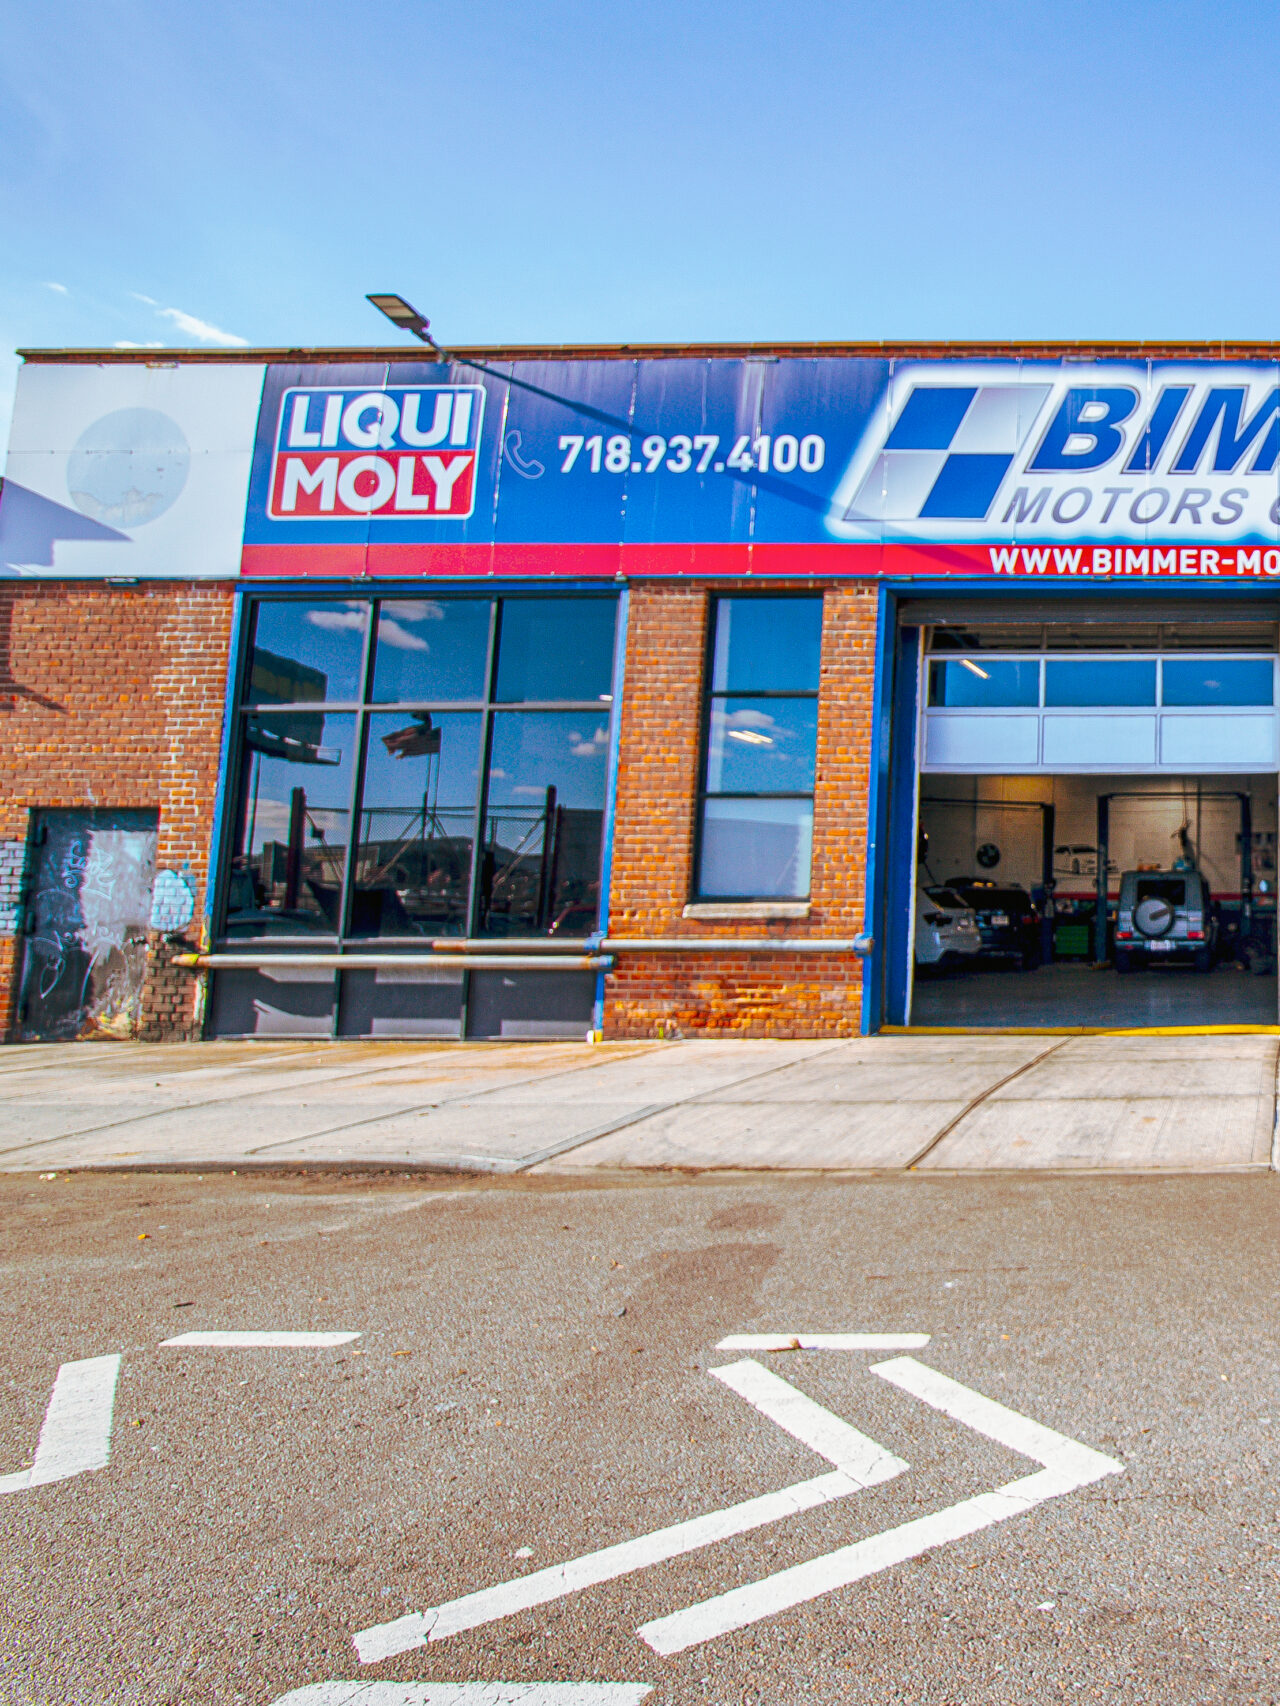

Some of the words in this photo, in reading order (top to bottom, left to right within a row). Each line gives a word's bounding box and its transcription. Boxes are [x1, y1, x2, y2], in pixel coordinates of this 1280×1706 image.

[288, 393, 473, 449] LIQUI
[559, 435, 825, 473] 718.937.4100
[281, 456, 474, 512] MOLY
[1001, 486, 1249, 526] MOTORS
